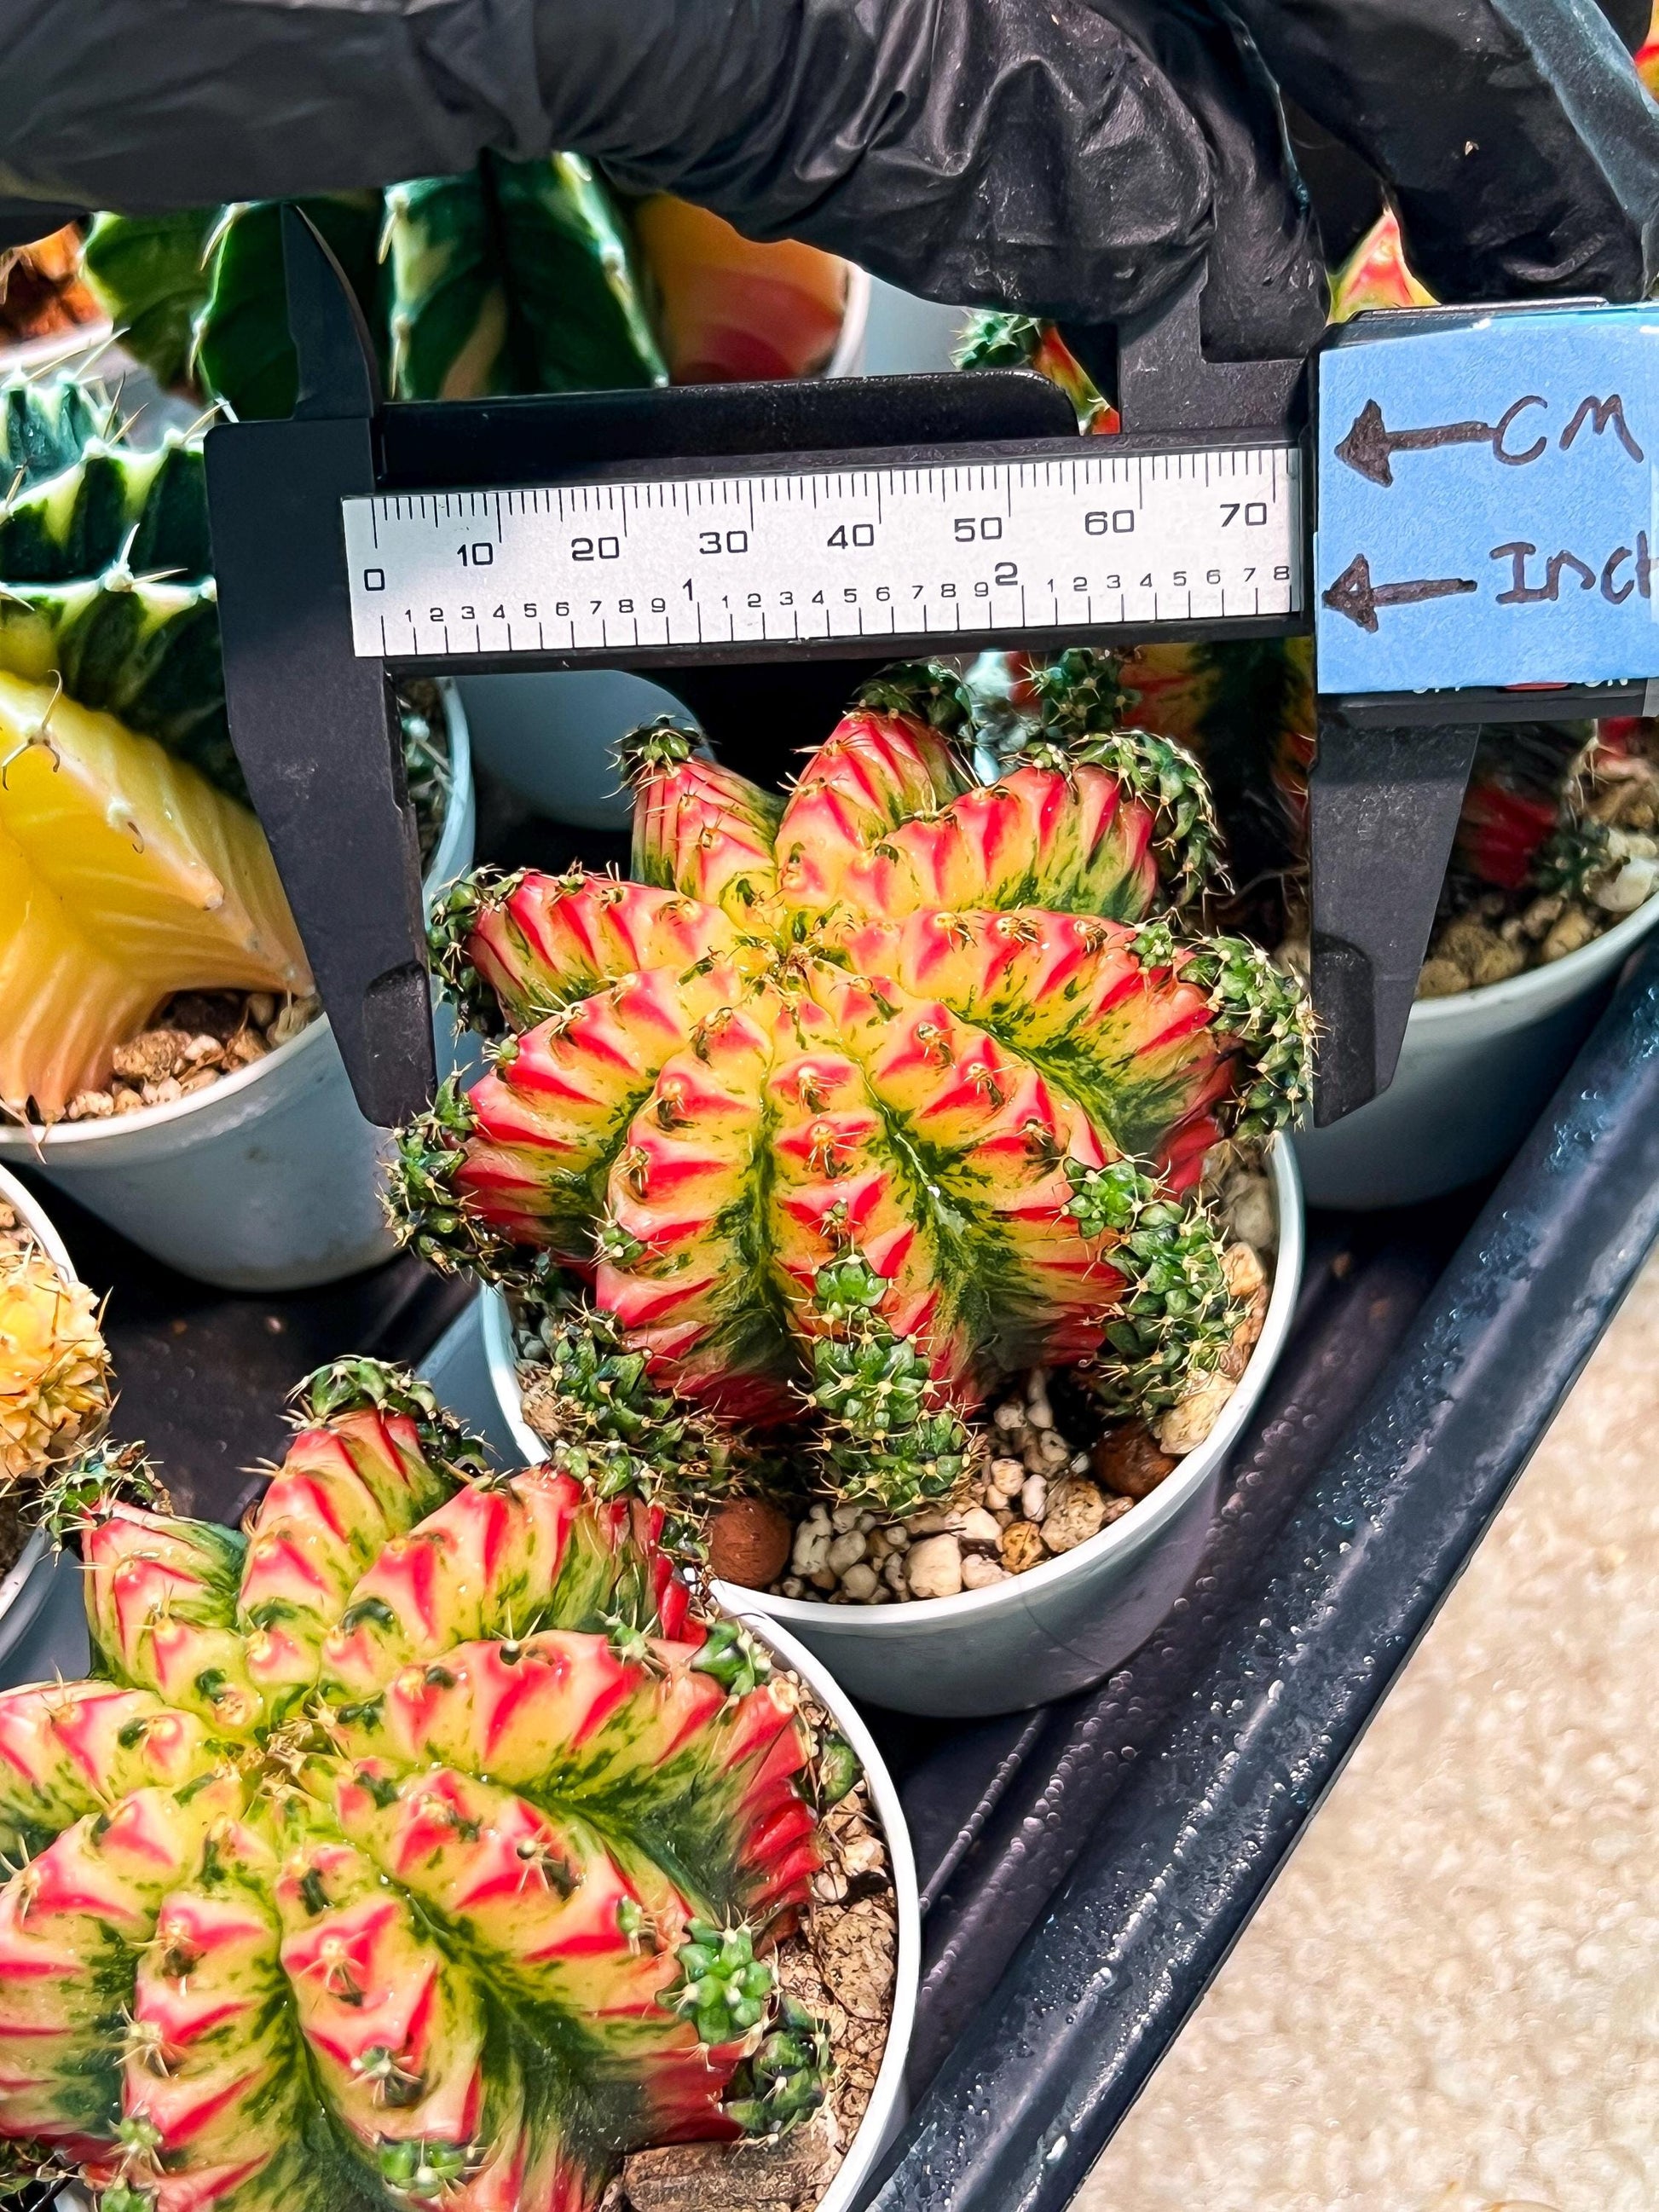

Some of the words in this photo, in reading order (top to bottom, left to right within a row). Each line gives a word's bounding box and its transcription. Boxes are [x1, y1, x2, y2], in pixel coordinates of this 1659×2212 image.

[456, 543, 494, 567] 10
[570, 537, 620, 562] 20
[699, 531, 749, 555] 30
[827, 524, 875, 550] 40
[954, 517, 1003, 543] 50
[1084, 510, 1135, 535] 60
[1219, 502, 1268, 528] 70
[363, 568, 385, 592] 0
[403, 609, 412, 623] 1
[429, 607, 444, 622] 2
[461, 605, 476, 620] 3
[492, 604, 506, 620] 4
[523, 603, 537, 618] 5
[555, 601, 569, 617] 6
[589, 600, 603, 615] 7
[618, 598, 634, 614] 8
[650, 598, 666, 613] 9
[682, 578, 693, 602] 1
[721, 595, 728, 609] 1
[747, 592, 761, 608] 2
[779, 591, 794, 606] 3
[812, 589, 824, 605] 4
[843, 588, 857, 604] 5
[876, 586, 891, 602] 6
[911, 585, 924, 600] 7
[940, 583, 957, 598] 8
[974, 581, 989, 598] 9
[994, 562, 1018, 586] 2
[1047, 578, 1054, 592] 1
[1072, 576, 1088, 592] 2
[1107, 575, 1121, 589] 3
[1139, 573, 1153, 588] 4
[1173, 570, 1187, 586] 5
[1206, 569, 1221, 585] 6
[1244, 567, 1257, 582] 7
[1274, 565, 1291, 581] 8
